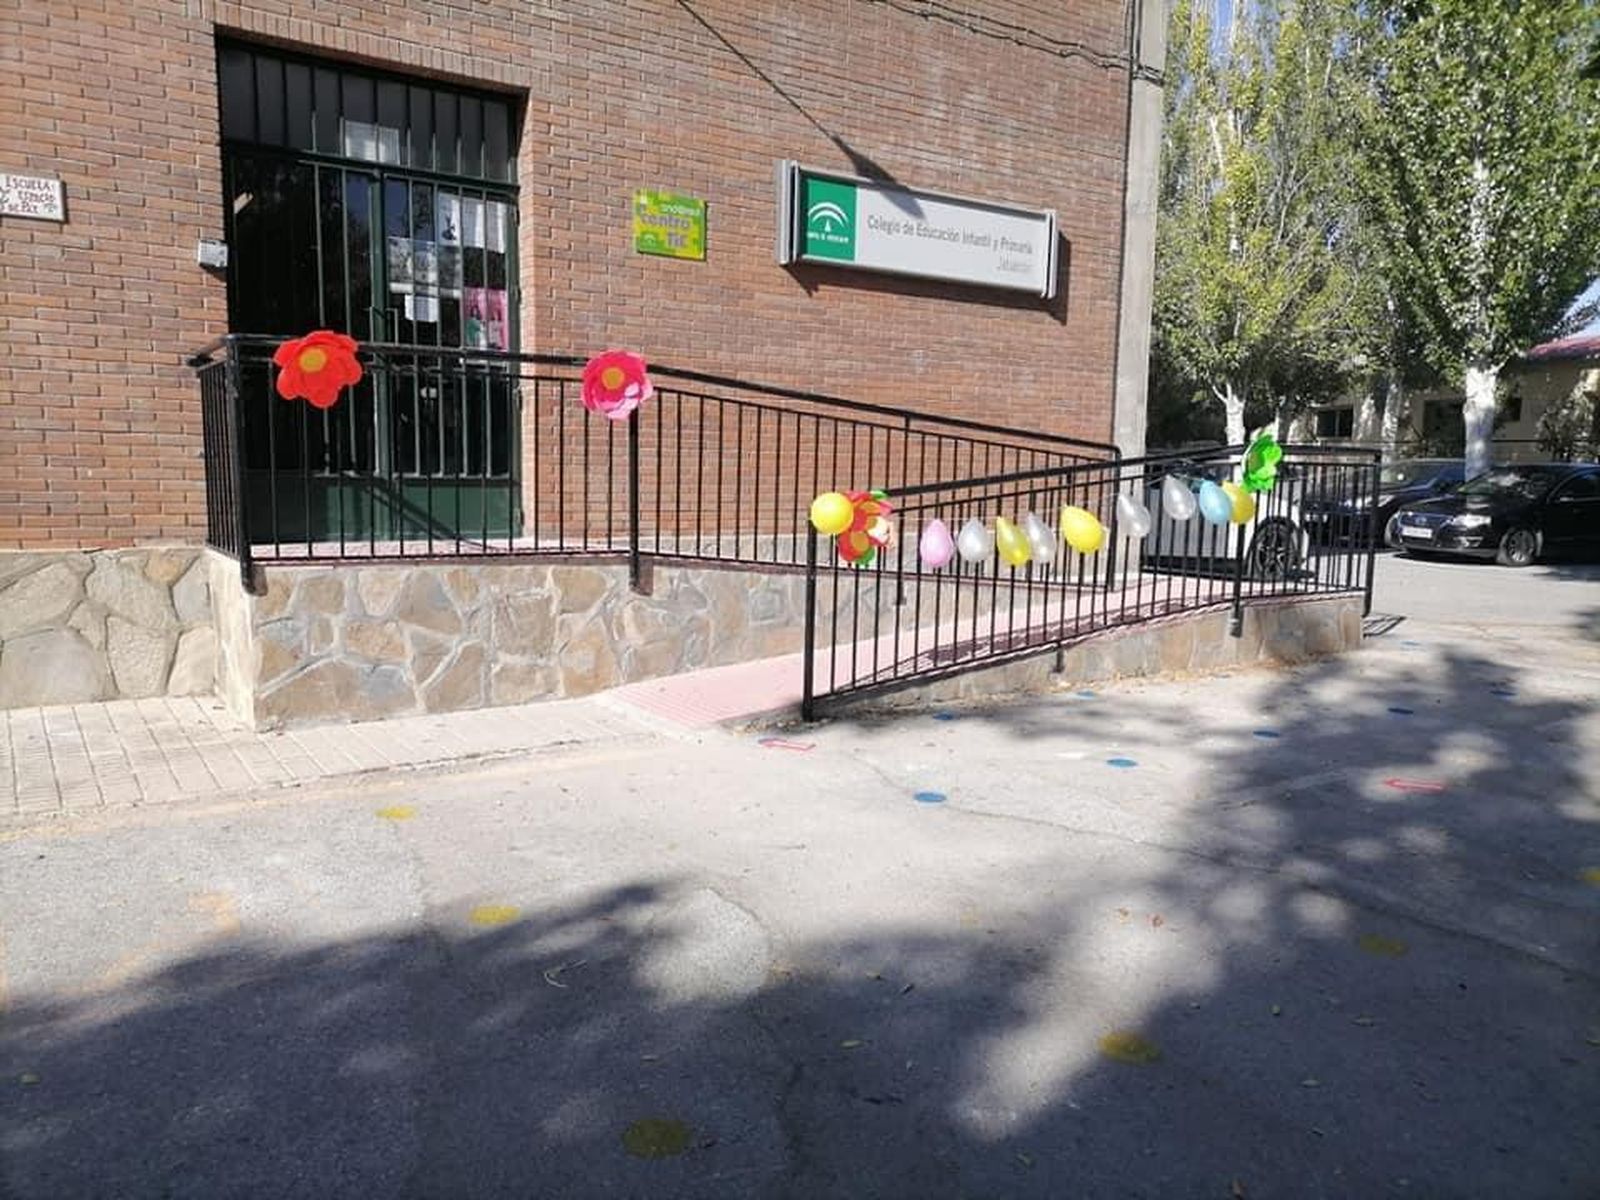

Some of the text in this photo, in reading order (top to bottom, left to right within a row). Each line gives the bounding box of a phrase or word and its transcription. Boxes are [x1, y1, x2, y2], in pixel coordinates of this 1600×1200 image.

[867, 214, 900, 237] Colegio
[902, 221, 915, 236] de
[916, 222, 960, 243] Educación
[962, 226, 991, 248] Infantil
